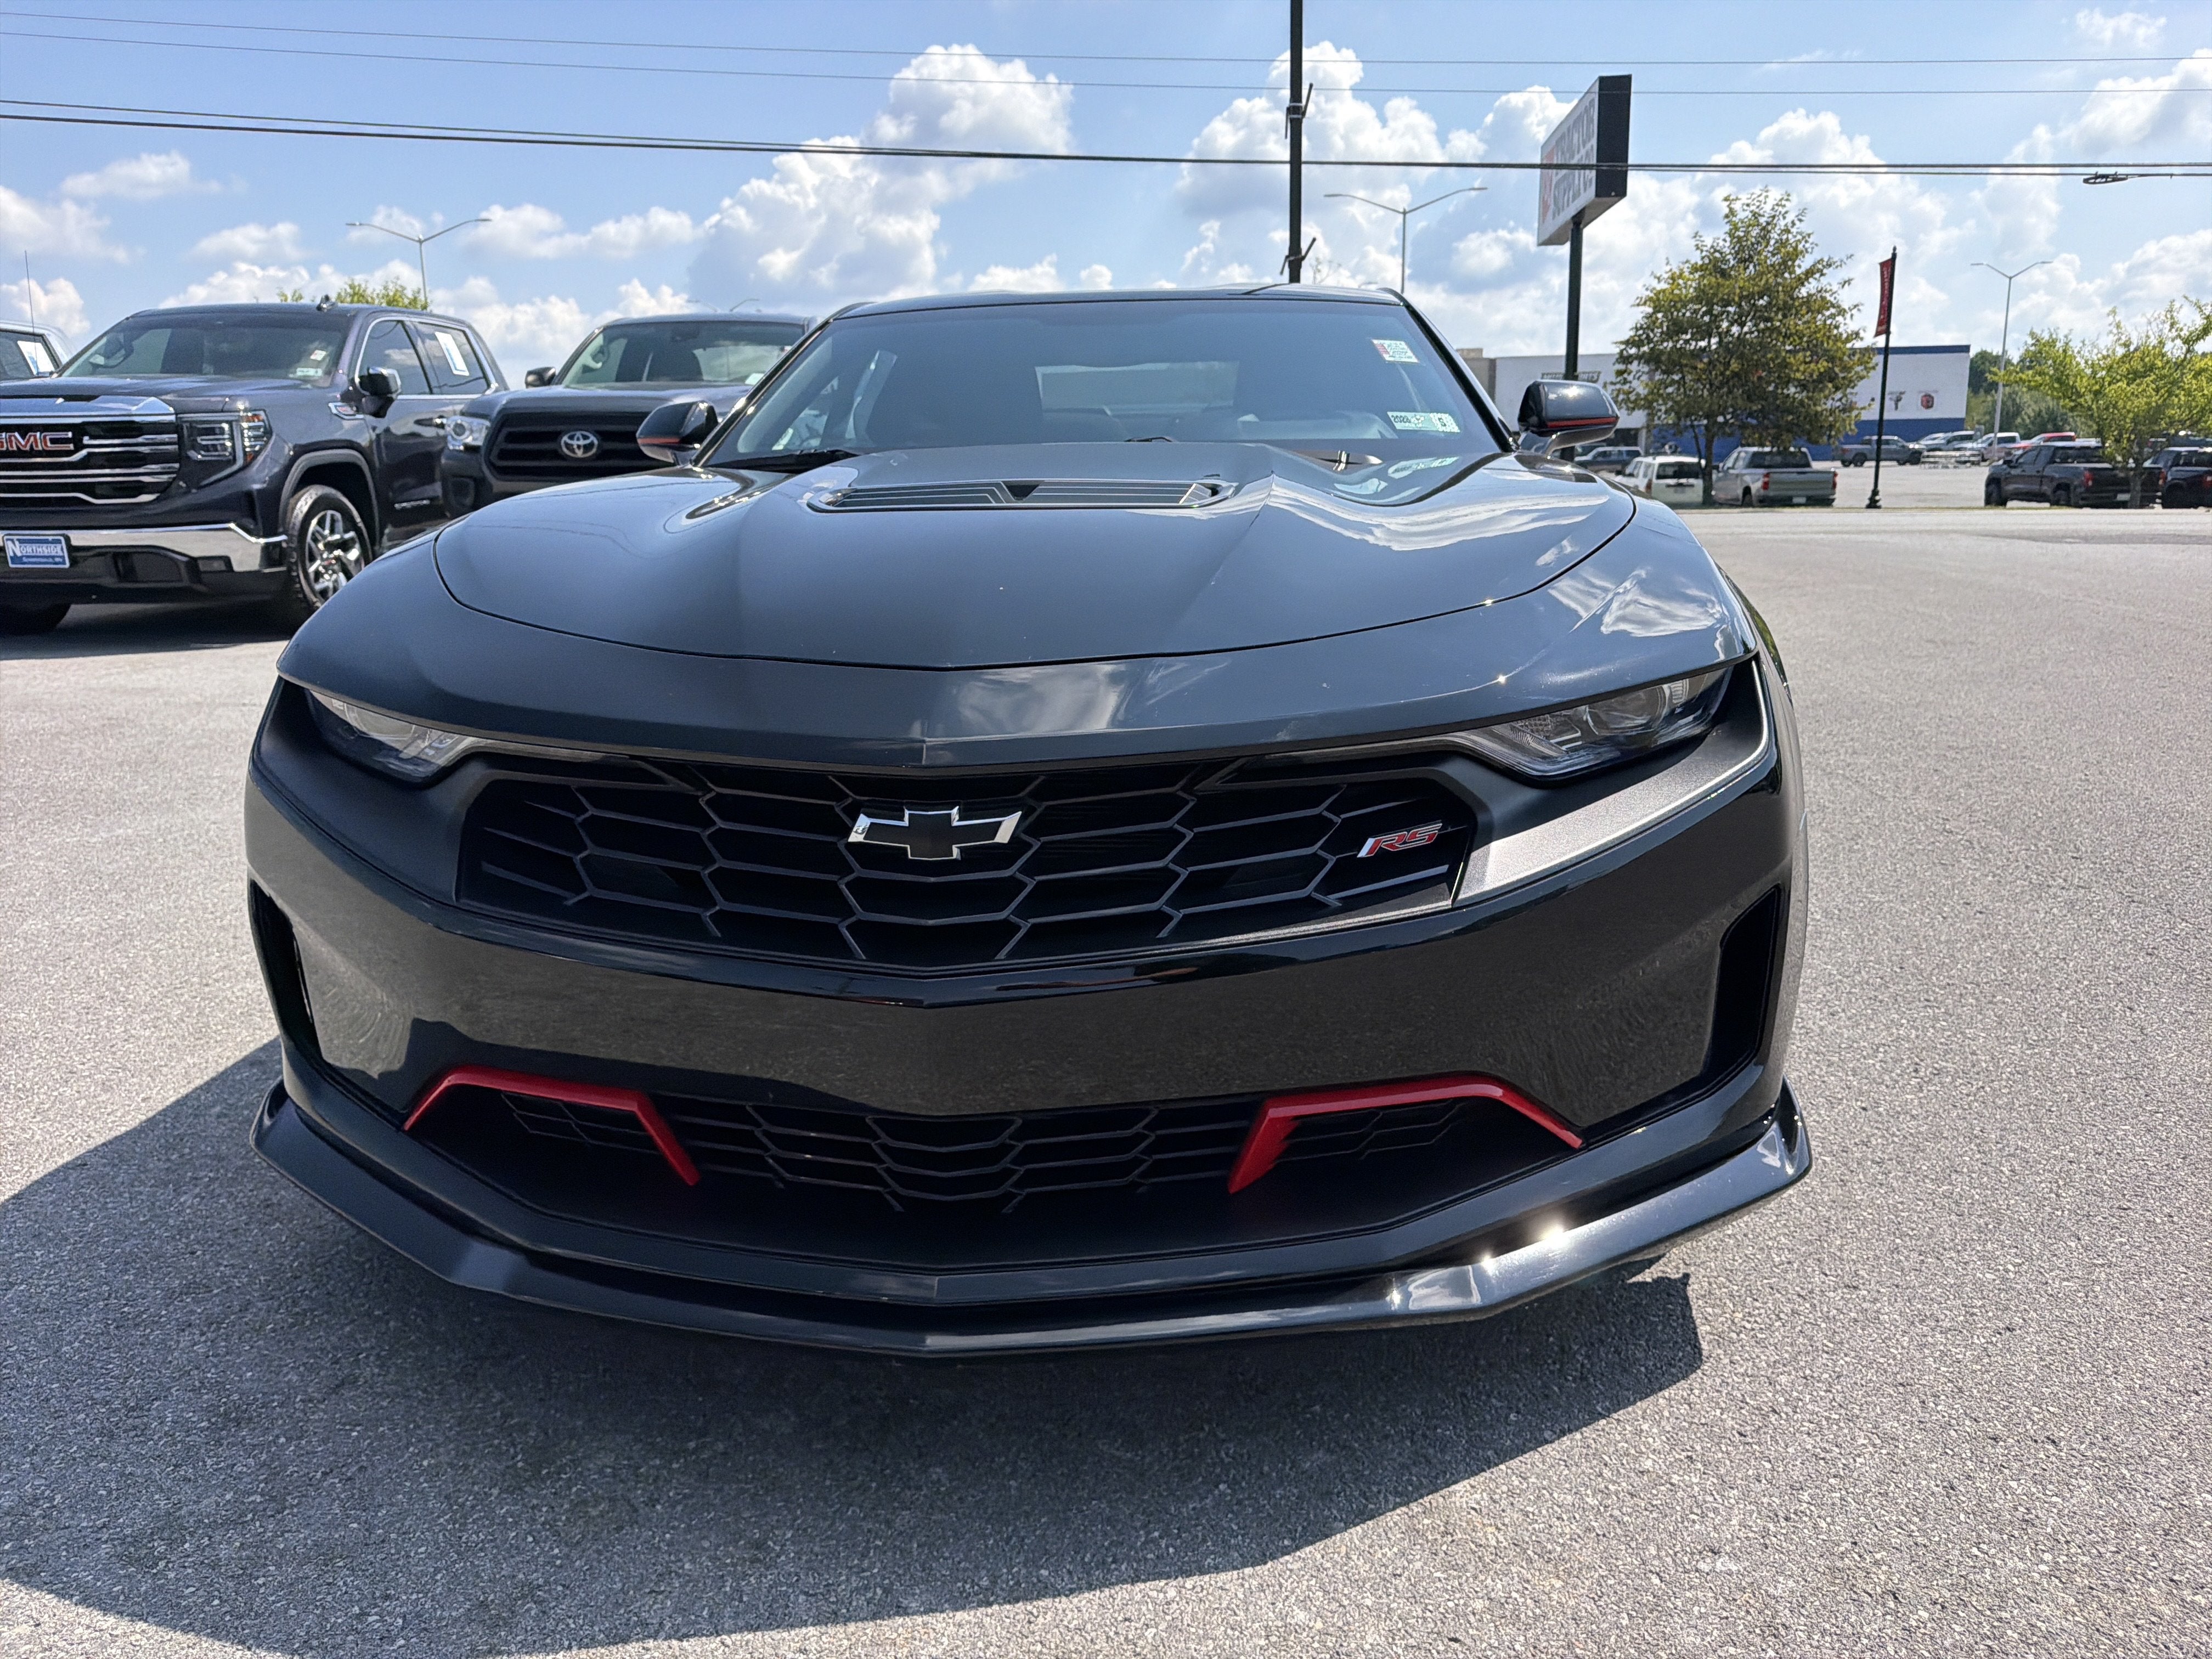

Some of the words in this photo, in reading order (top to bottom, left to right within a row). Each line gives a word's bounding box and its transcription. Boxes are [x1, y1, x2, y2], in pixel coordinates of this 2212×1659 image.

[0, 432, 74, 450] MC
[7, 539, 64, 557] NORTHSIDE
[1357, 823, 1443, 857] RS
